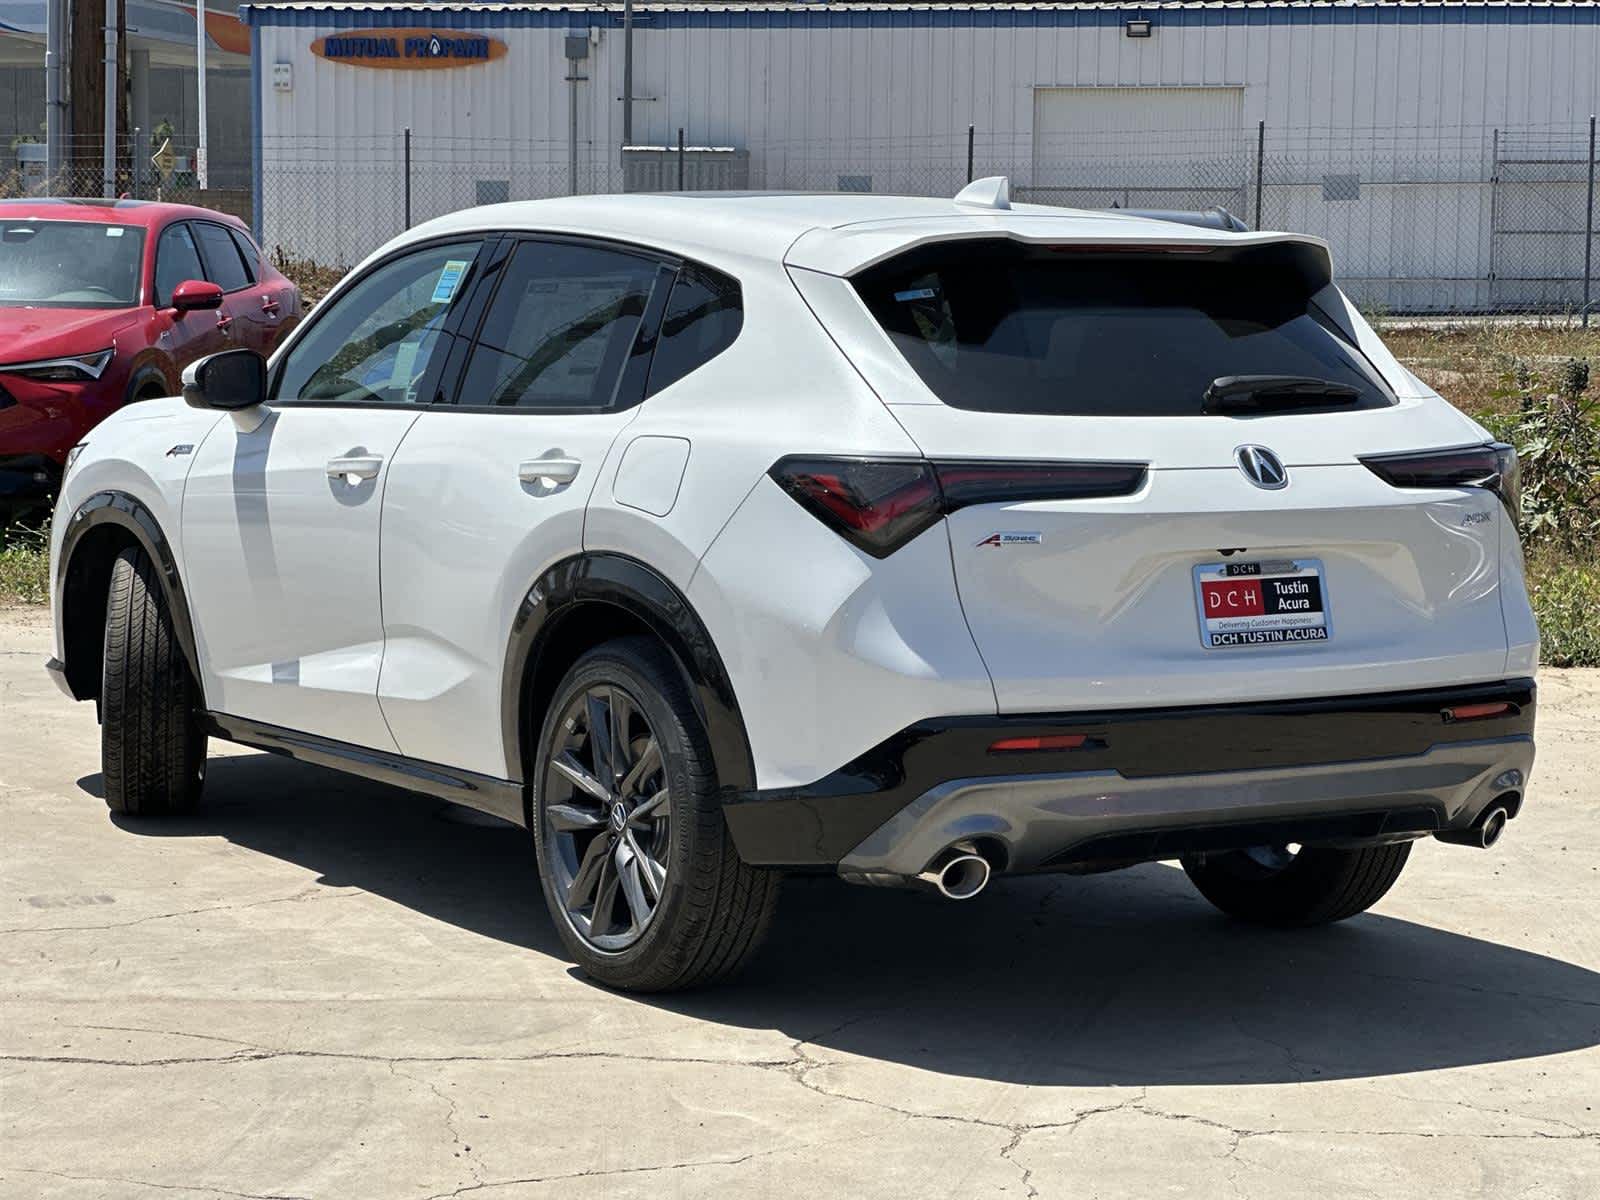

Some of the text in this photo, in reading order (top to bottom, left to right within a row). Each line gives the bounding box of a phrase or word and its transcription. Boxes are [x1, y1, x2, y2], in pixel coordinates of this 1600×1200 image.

[326, 34, 488, 58] MUTUAL PROPANE
[1233, 564, 1256, 575] DCH
[1273, 580, 1309, 595] Tustin
[1209, 590, 1257, 609] DCH
[1278, 598, 1310, 611] Acura
[1218, 617, 1312, 630] Delivering Customer Happiness
[1212, 627, 1326, 646] DCH TUSTIN ACURA
